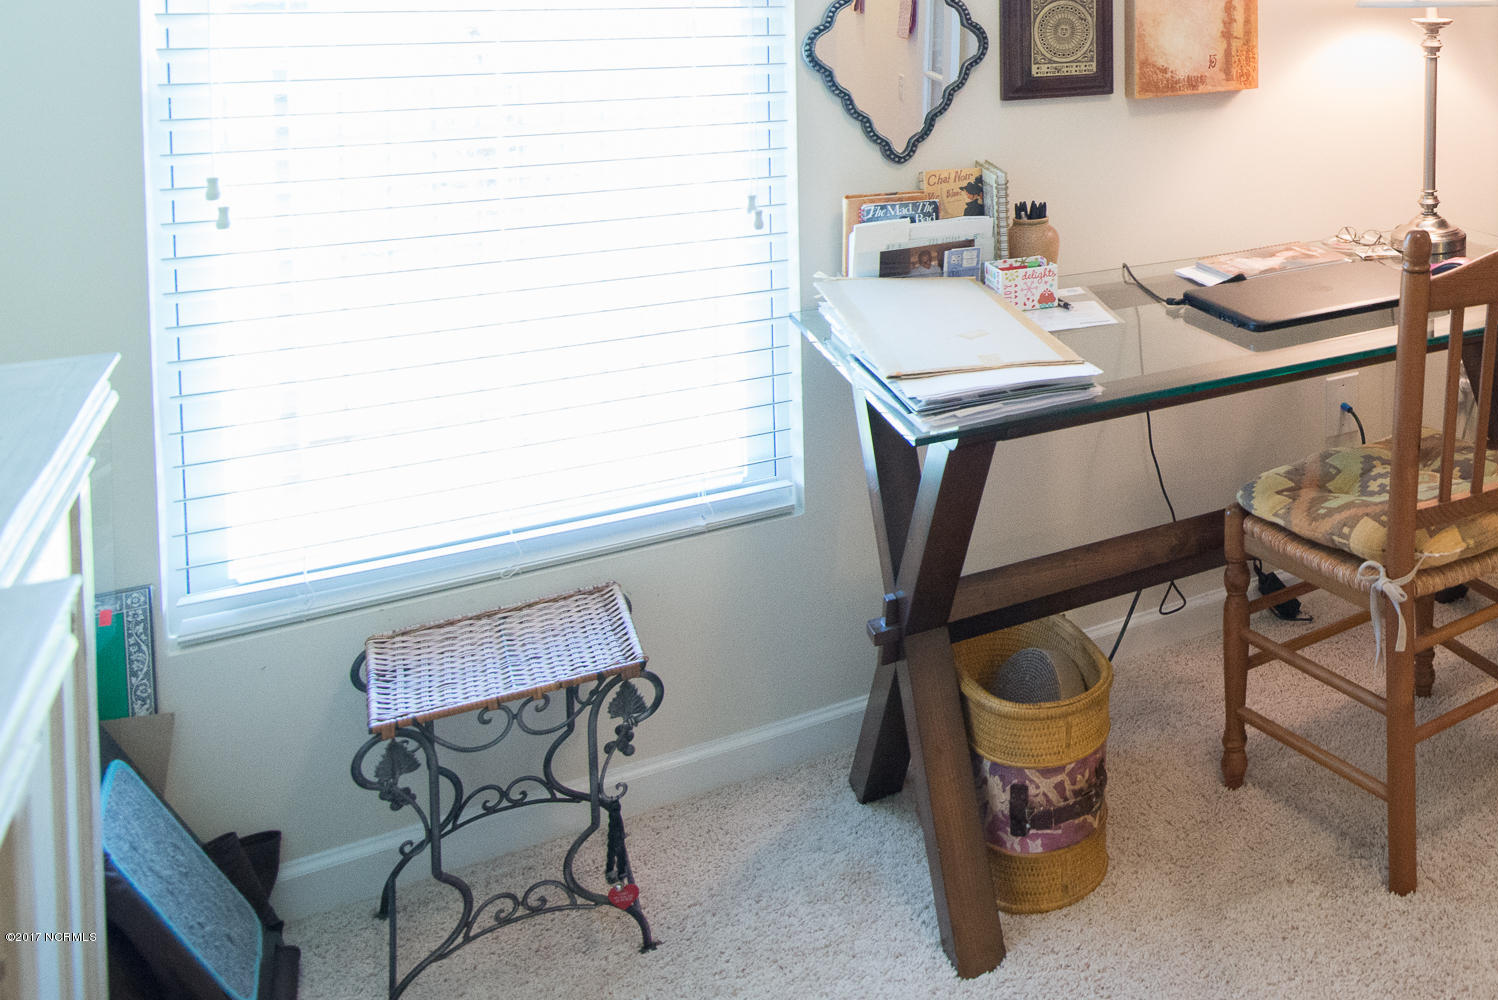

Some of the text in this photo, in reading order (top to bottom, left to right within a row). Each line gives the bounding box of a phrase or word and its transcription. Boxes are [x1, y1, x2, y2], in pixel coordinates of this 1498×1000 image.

[864, 205, 887, 218] The
[914, 201, 935, 213] The
[1022, 267, 1057, 284] delights
